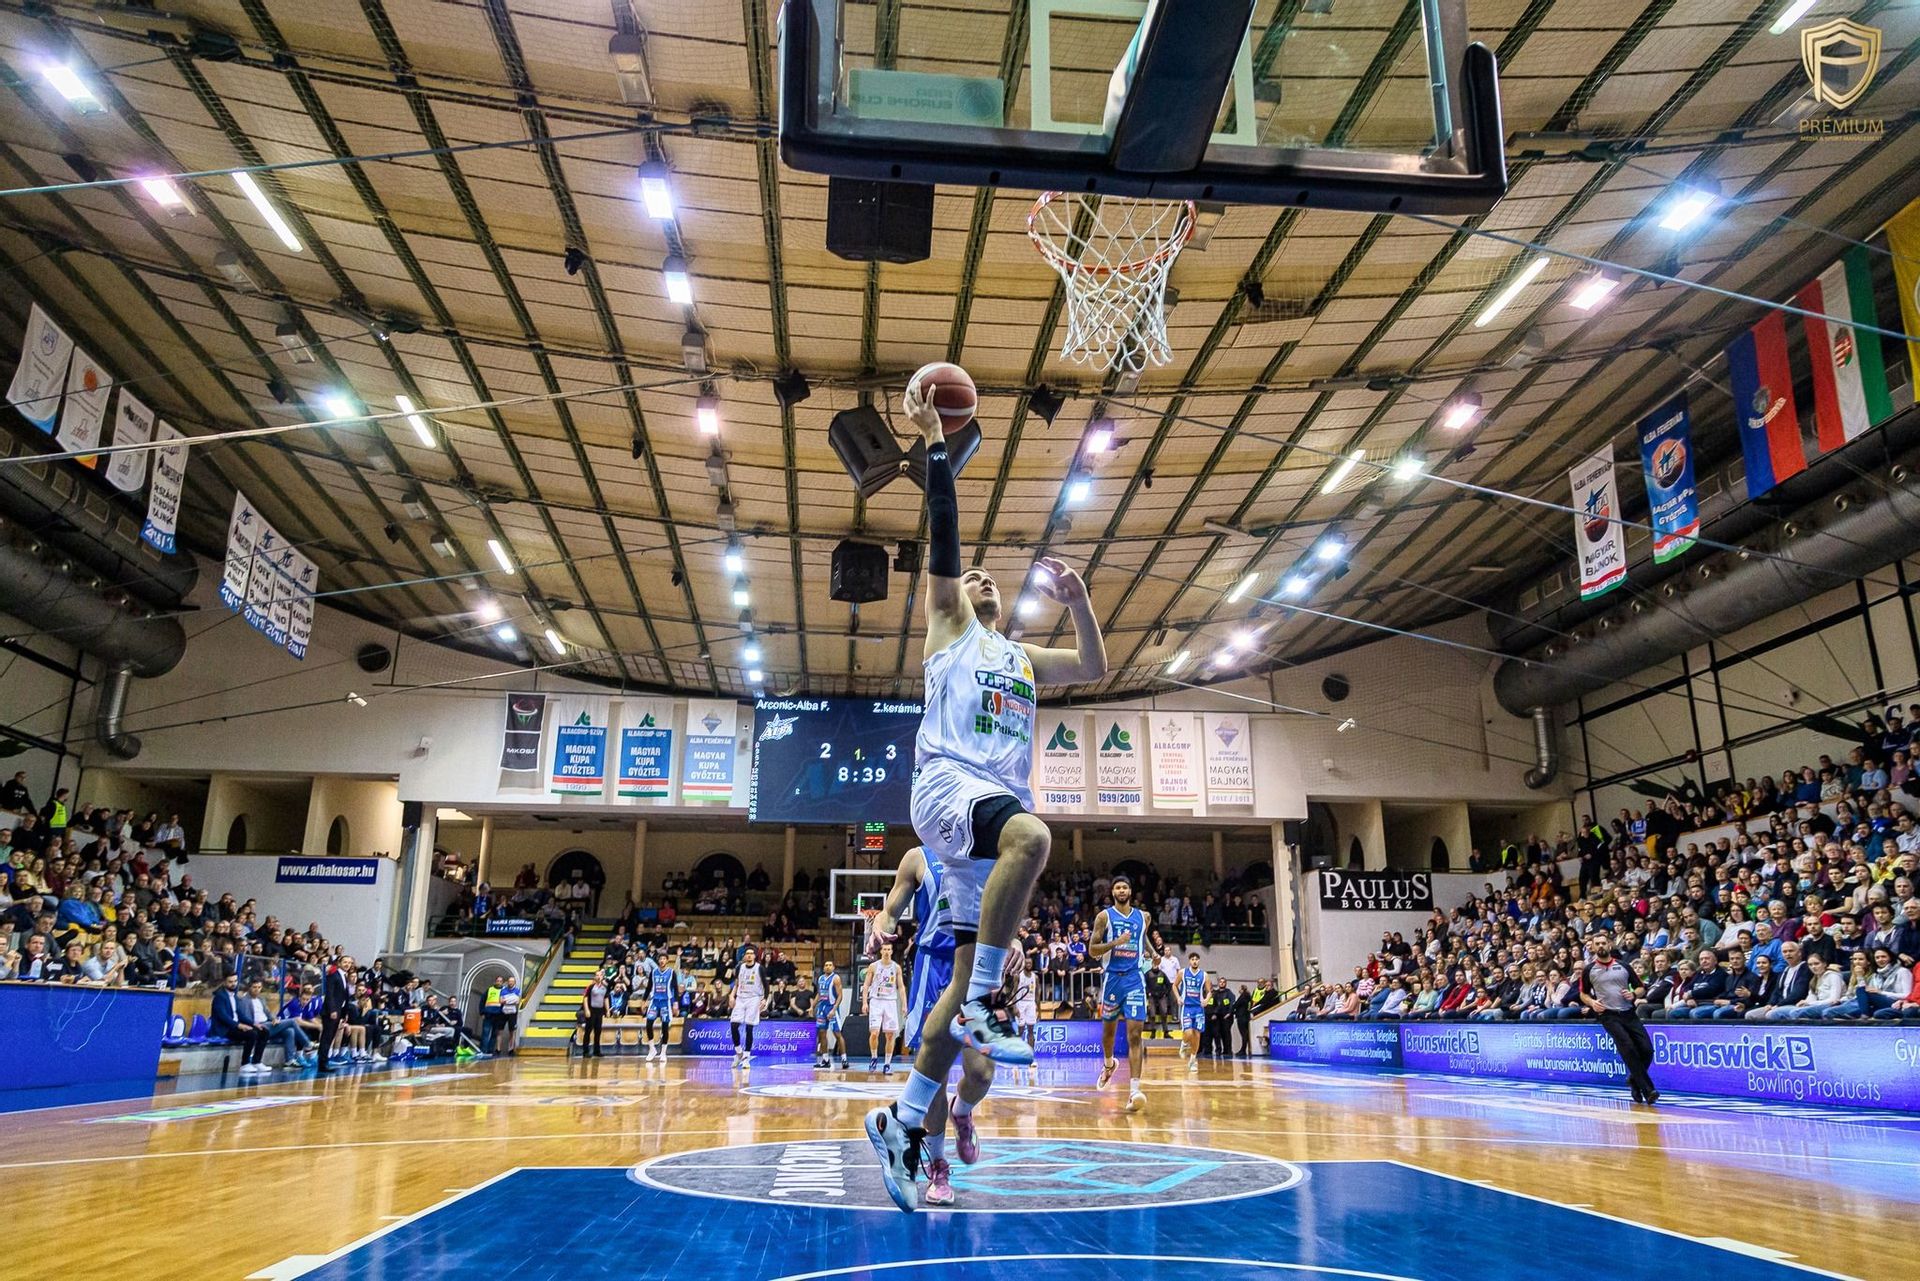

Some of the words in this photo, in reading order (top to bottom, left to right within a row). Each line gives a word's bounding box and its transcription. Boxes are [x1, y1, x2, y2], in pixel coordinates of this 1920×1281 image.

[873, 703, 922, 714] Z.kerámia
[565, 745, 596, 754] MAGYAR
[630, 746, 661, 756] MAGYAR
[820, 743, 832, 759] 2
[886, 744, 897, 760] 3
[570, 755, 590, 764] KUPA
[693, 751, 726, 760] MAGYAR
[635, 757, 655, 766] KUPA
[698, 761, 720, 769] KUPA
[562, 765, 596, 775] GYŐZTES
[628, 767, 661, 777] GYŐZTES
[838, 767, 886, 782] 8:39
[1044, 766, 1082, 775] MAGYAR
[1099, 766, 1137, 775] MAGYAR
[1209, 766, 1249, 774] MAGYAR
[690, 771, 727, 780] GYŐZTES
[1045, 776, 1081, 784] BAJNOK
[1100, 776, 1136, 784] BAJNOK
[1210, 777, 1249, 786] BAJNOK
[1045, 793, 1082, 804] 1998/99
[1098, 792, 1140, 803] 1999/2000
[280, 864, 375, 877] www.albakosar.hu
[1341, 899, 1413, 909] BORHÁZ
[774, 1029, 810, 1041] Telepítés
[1405, 1028, 1467, 1055] Brunswick
[1546, 1030, 1594, 1053] Értékesítés,
[1060, 1042, 1101, 1053] Products
[1653, 1032, 1786, 1072] Brunswick
[1449, 1055, 1475, 1073] Bowling
[1476, 1056, 1508, 1073] Products
[1526, 1057, 1627, 1078] www.brunswick-bowling.hu
[1748, 1071, 1805, 1100] Bowling
[1807, 1075, 1881, 1101] Products
[768, 1145, 846, 1197] ARCONIC
